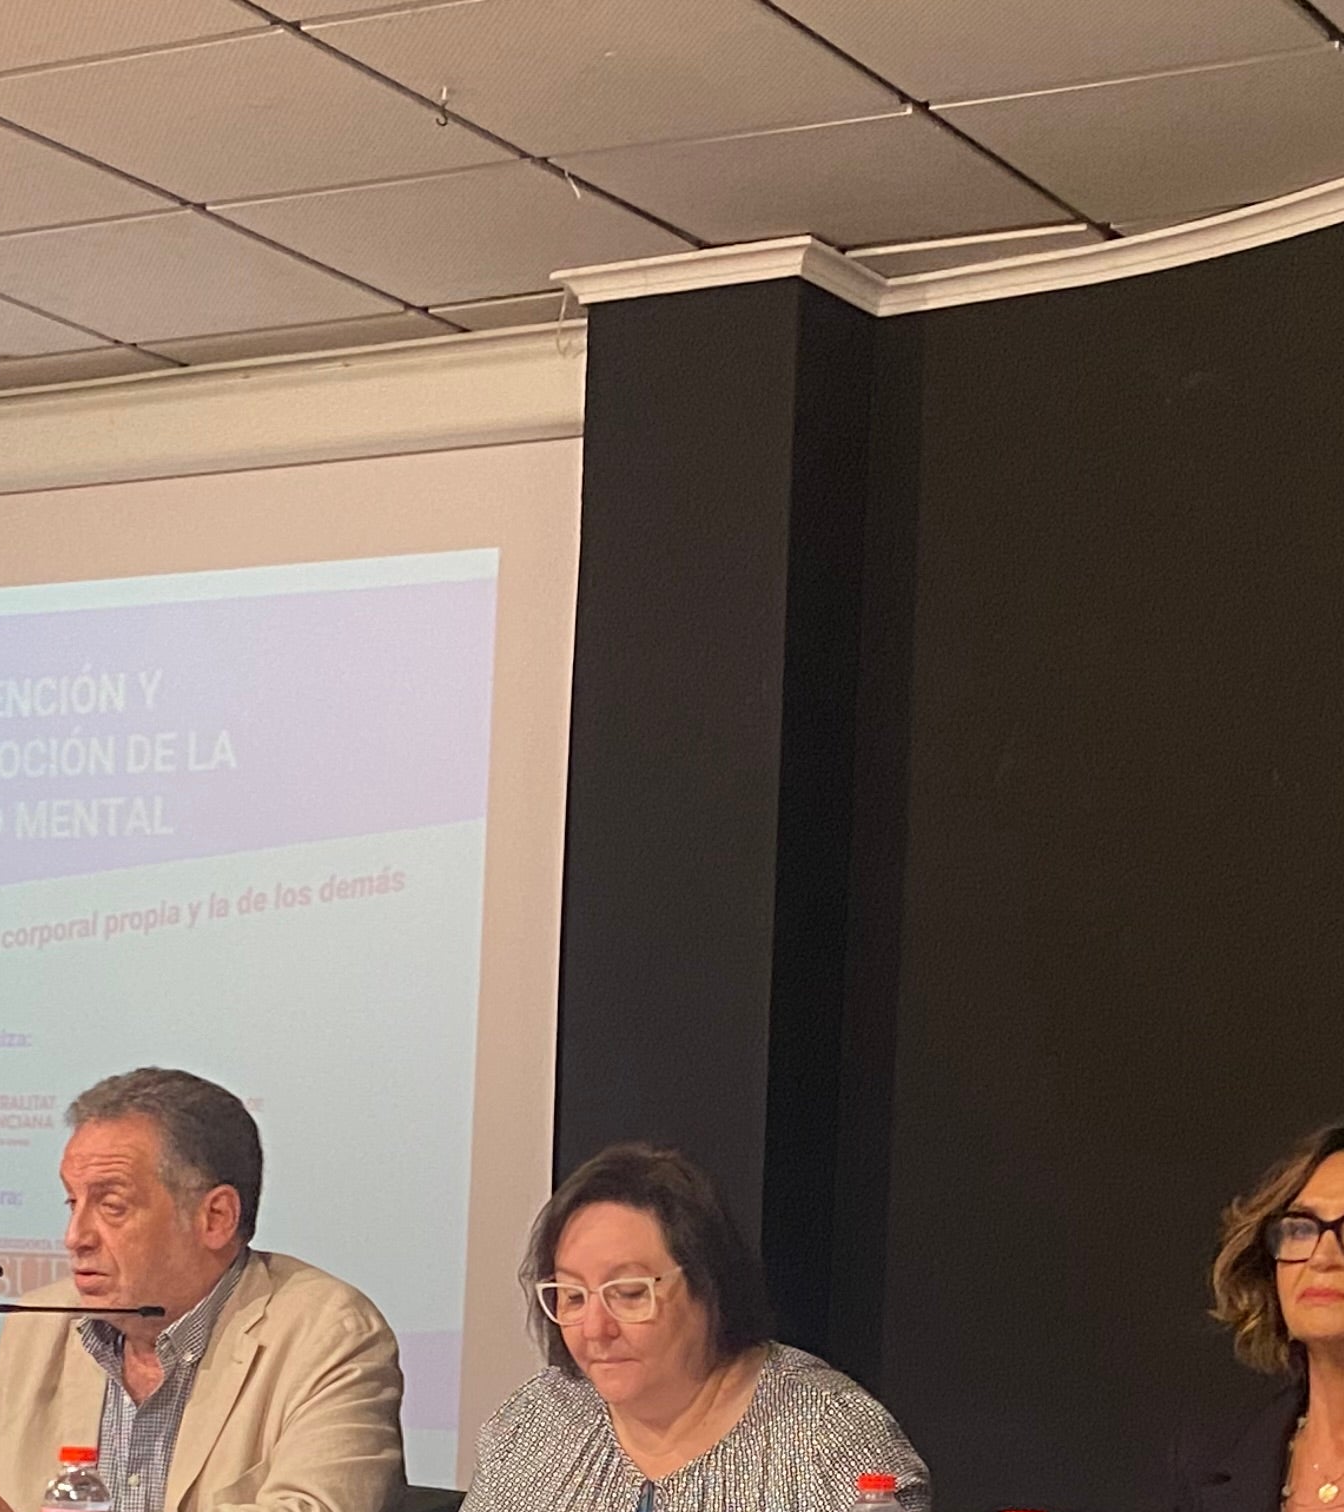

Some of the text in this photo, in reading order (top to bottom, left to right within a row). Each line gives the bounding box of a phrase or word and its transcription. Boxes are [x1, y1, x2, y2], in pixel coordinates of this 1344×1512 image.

[140, 667, 163, 710] Y
[126, 731, 177, 774] DE
[188, 729, 237, 772] LA
[15, 795, 174, 840] MENTAL
[1, 910, 97, 950] corporal
[103, 900, 180, 940] propia
[188, 900, 202, 928] y
[208, 891, 229, 918] la
[237, 886, 267, 915] de
[275, 882, 312, 910] los
[319, 867, 407, 903] demás
